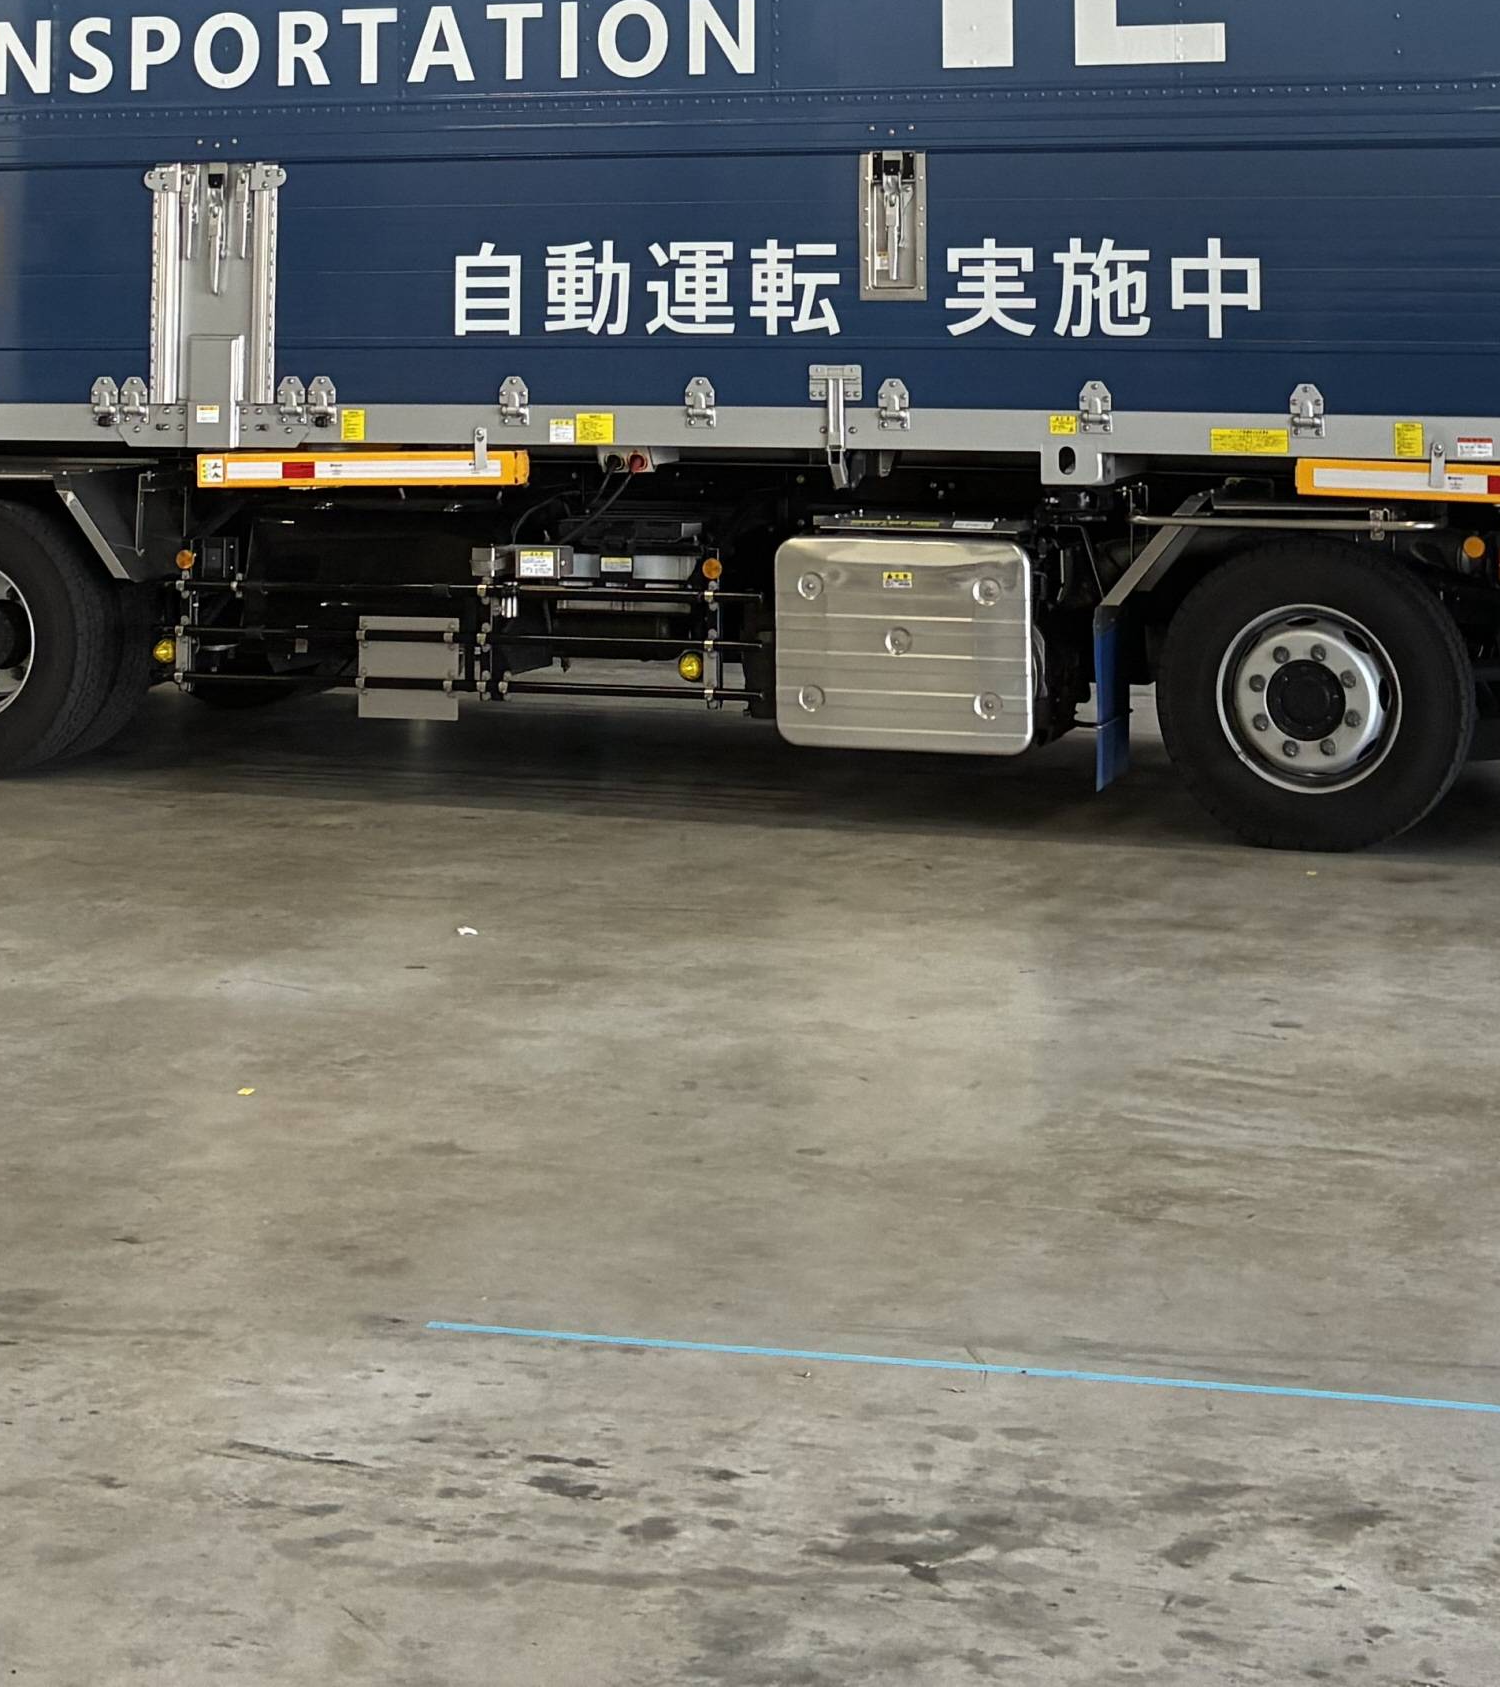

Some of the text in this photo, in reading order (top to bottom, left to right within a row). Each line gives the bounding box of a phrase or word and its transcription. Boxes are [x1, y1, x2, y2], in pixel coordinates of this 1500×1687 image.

[453, 237, 1262, 340] 自動運転 実施中
